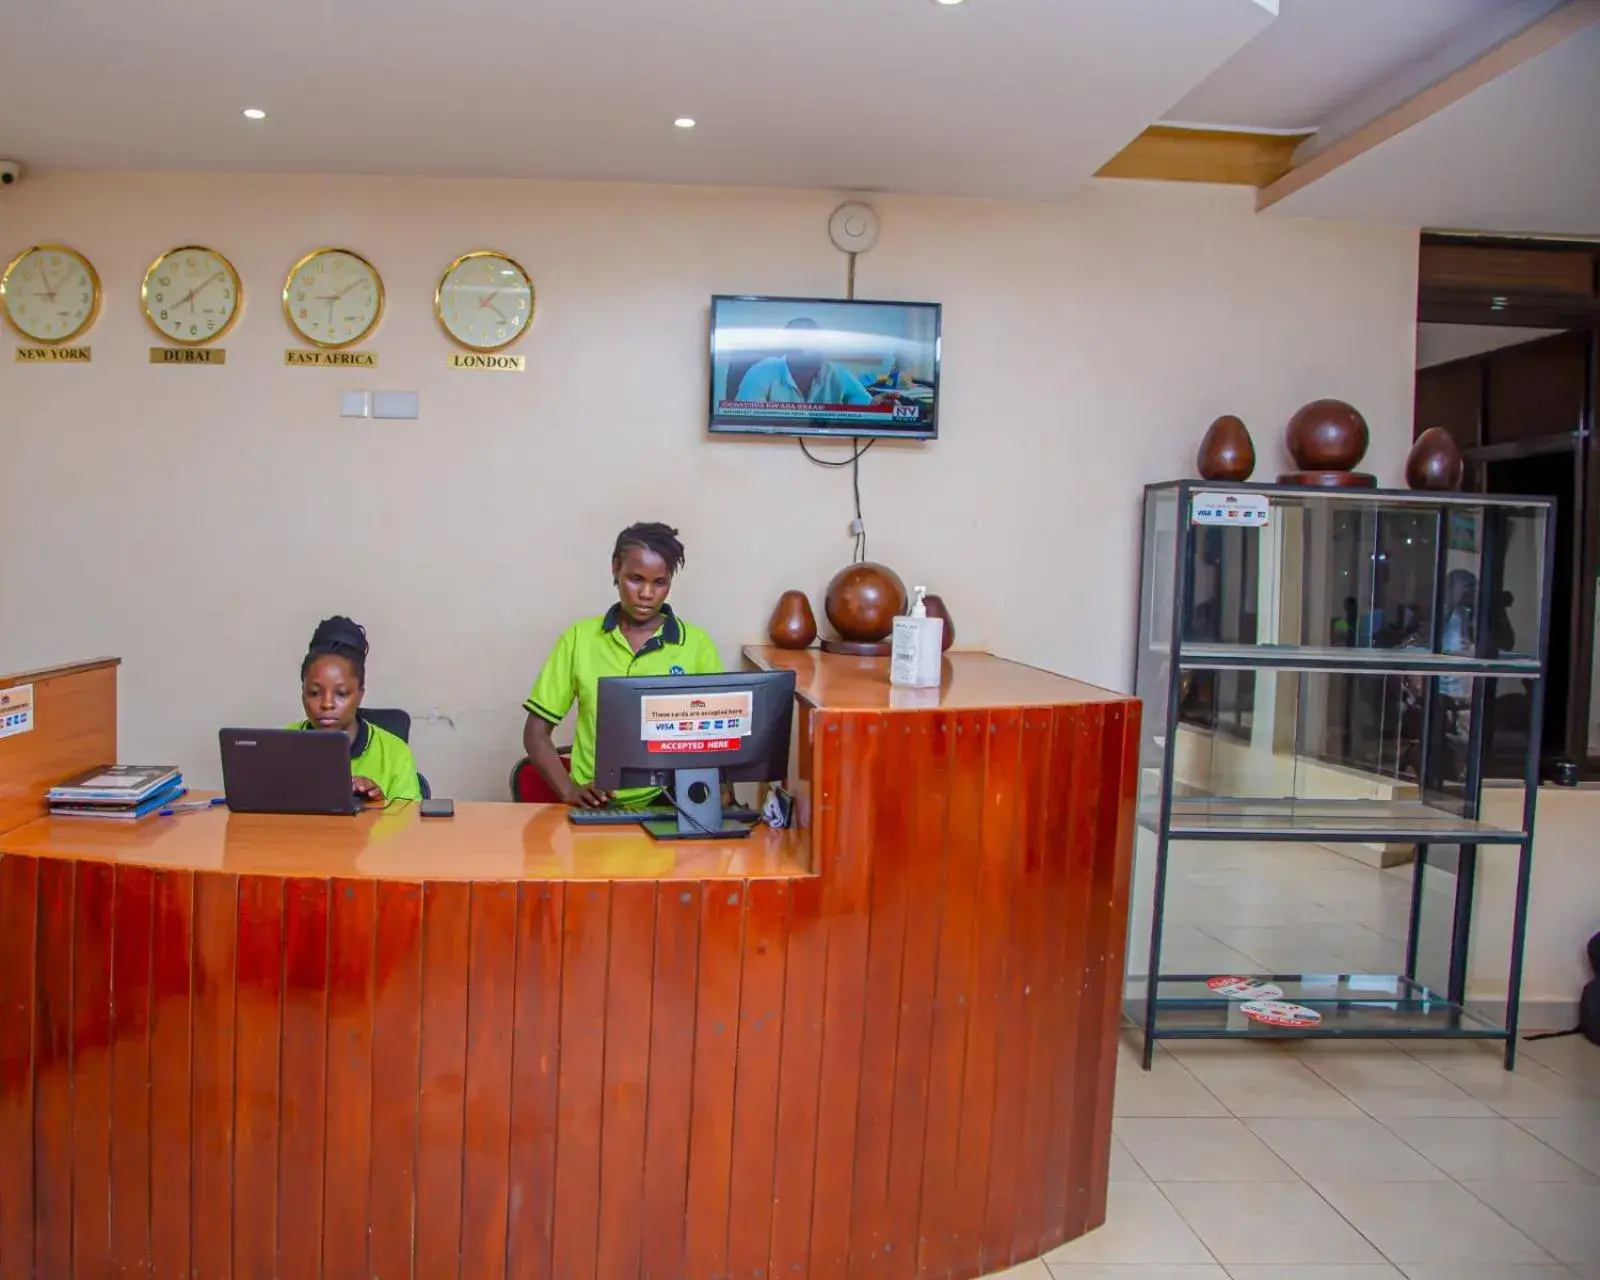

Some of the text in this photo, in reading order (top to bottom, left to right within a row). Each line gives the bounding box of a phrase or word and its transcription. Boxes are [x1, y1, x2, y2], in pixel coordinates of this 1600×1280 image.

[160, 308, 169, 321] 8
[189, 324, 198, 336] 6
[18, 348, 88, 360] NEW YORK
[164, 350, 210, 363] DUBAI
[288, 352, 373, 365] EAST AFRICA
[454, 355, 519, 369] LONDON
[656, 723, 675, 731] VISA
[661, 740, 729, 751] ACCEPTED HERE
